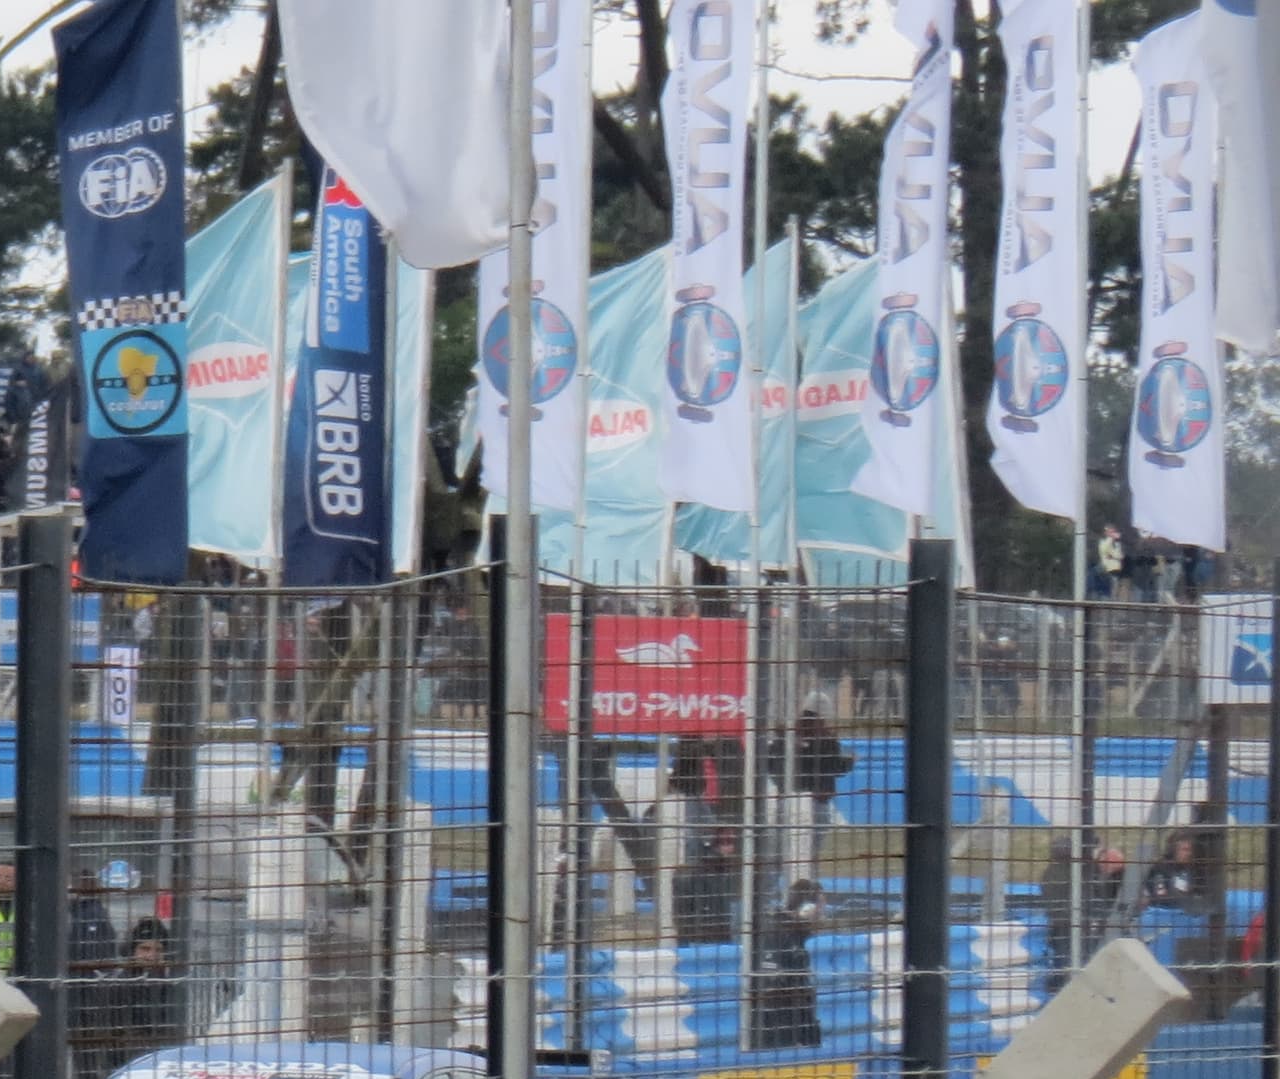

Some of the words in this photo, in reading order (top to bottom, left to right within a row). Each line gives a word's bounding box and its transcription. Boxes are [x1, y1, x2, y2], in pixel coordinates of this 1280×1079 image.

[67, 119, 144, 151] MEMBER
[148, 112, 174, 132] OF
[324, 213, 345, 334] America
[344, 217, 364, 303] South
[317, 421, 364, 516] BRB
